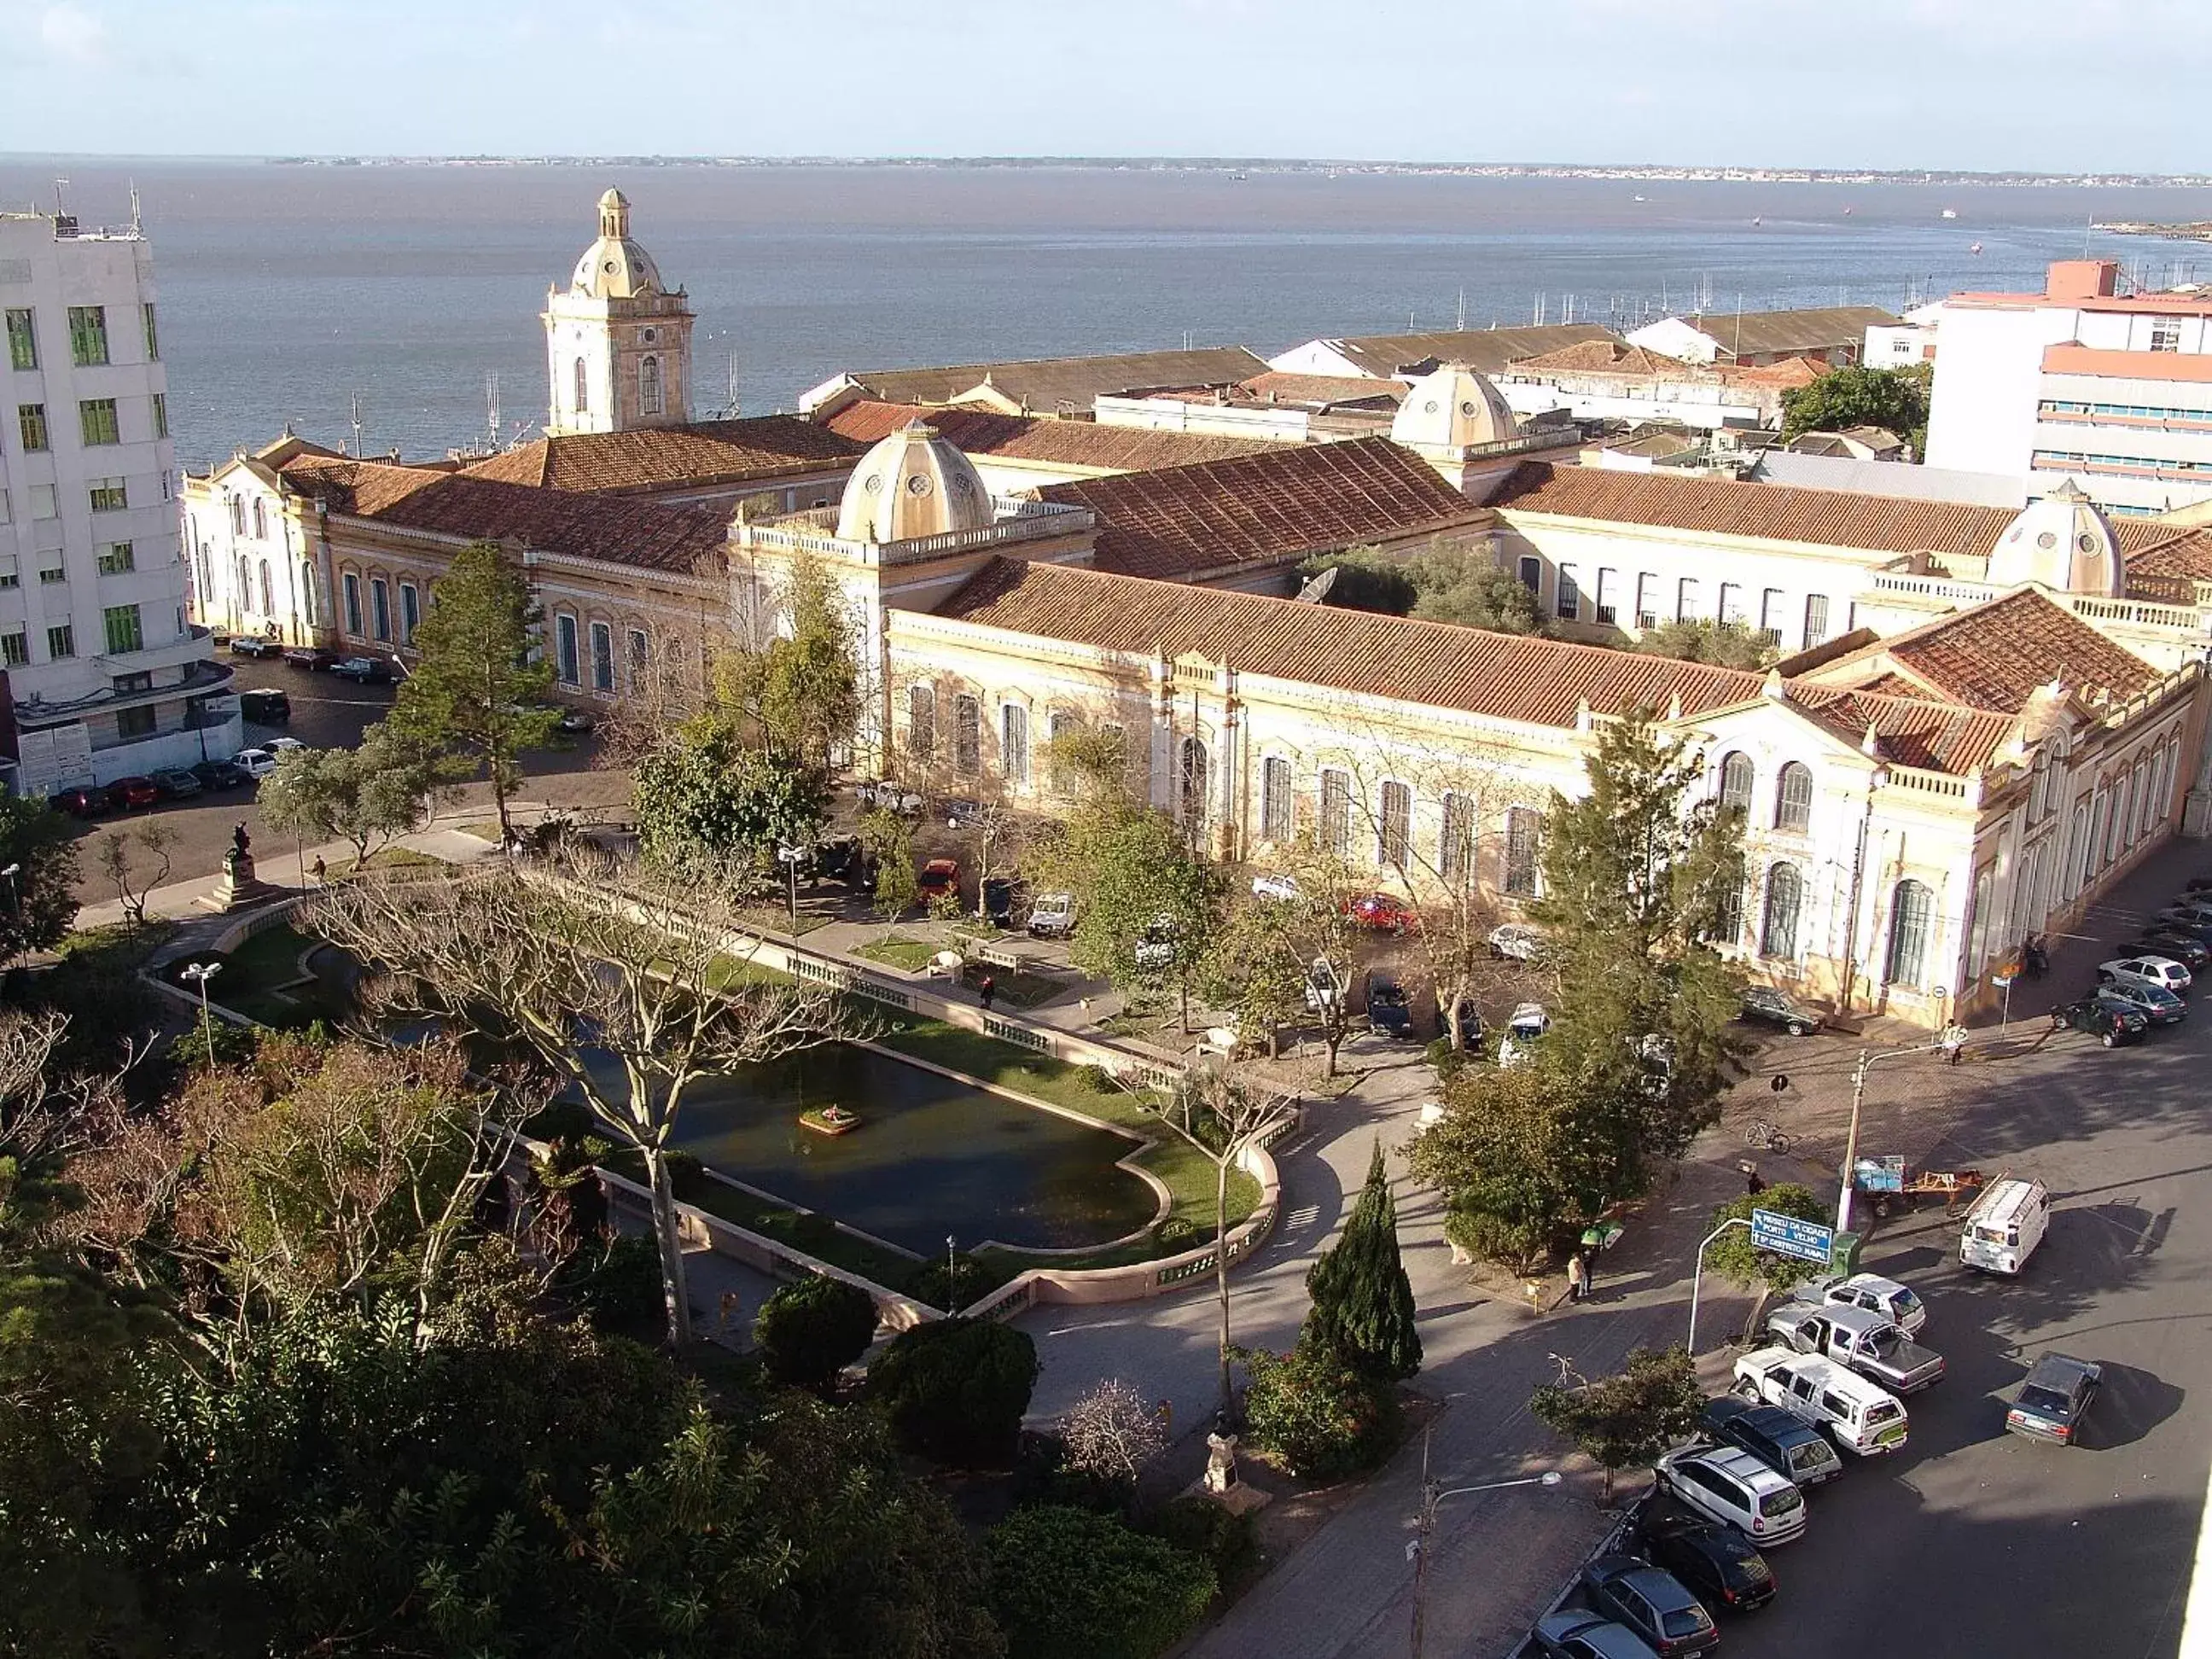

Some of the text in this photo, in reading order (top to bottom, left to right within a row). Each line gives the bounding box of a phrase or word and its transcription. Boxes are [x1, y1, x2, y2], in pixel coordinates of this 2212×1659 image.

[1763, 1224, 1818, 1244] PORTO VELHO
[1802, 1225, 1828, 1238] CIDADE
[1770, 1238, 1802, 1252] DISTRITO
[1805, 1249, 1826, 1260] NAVAL
